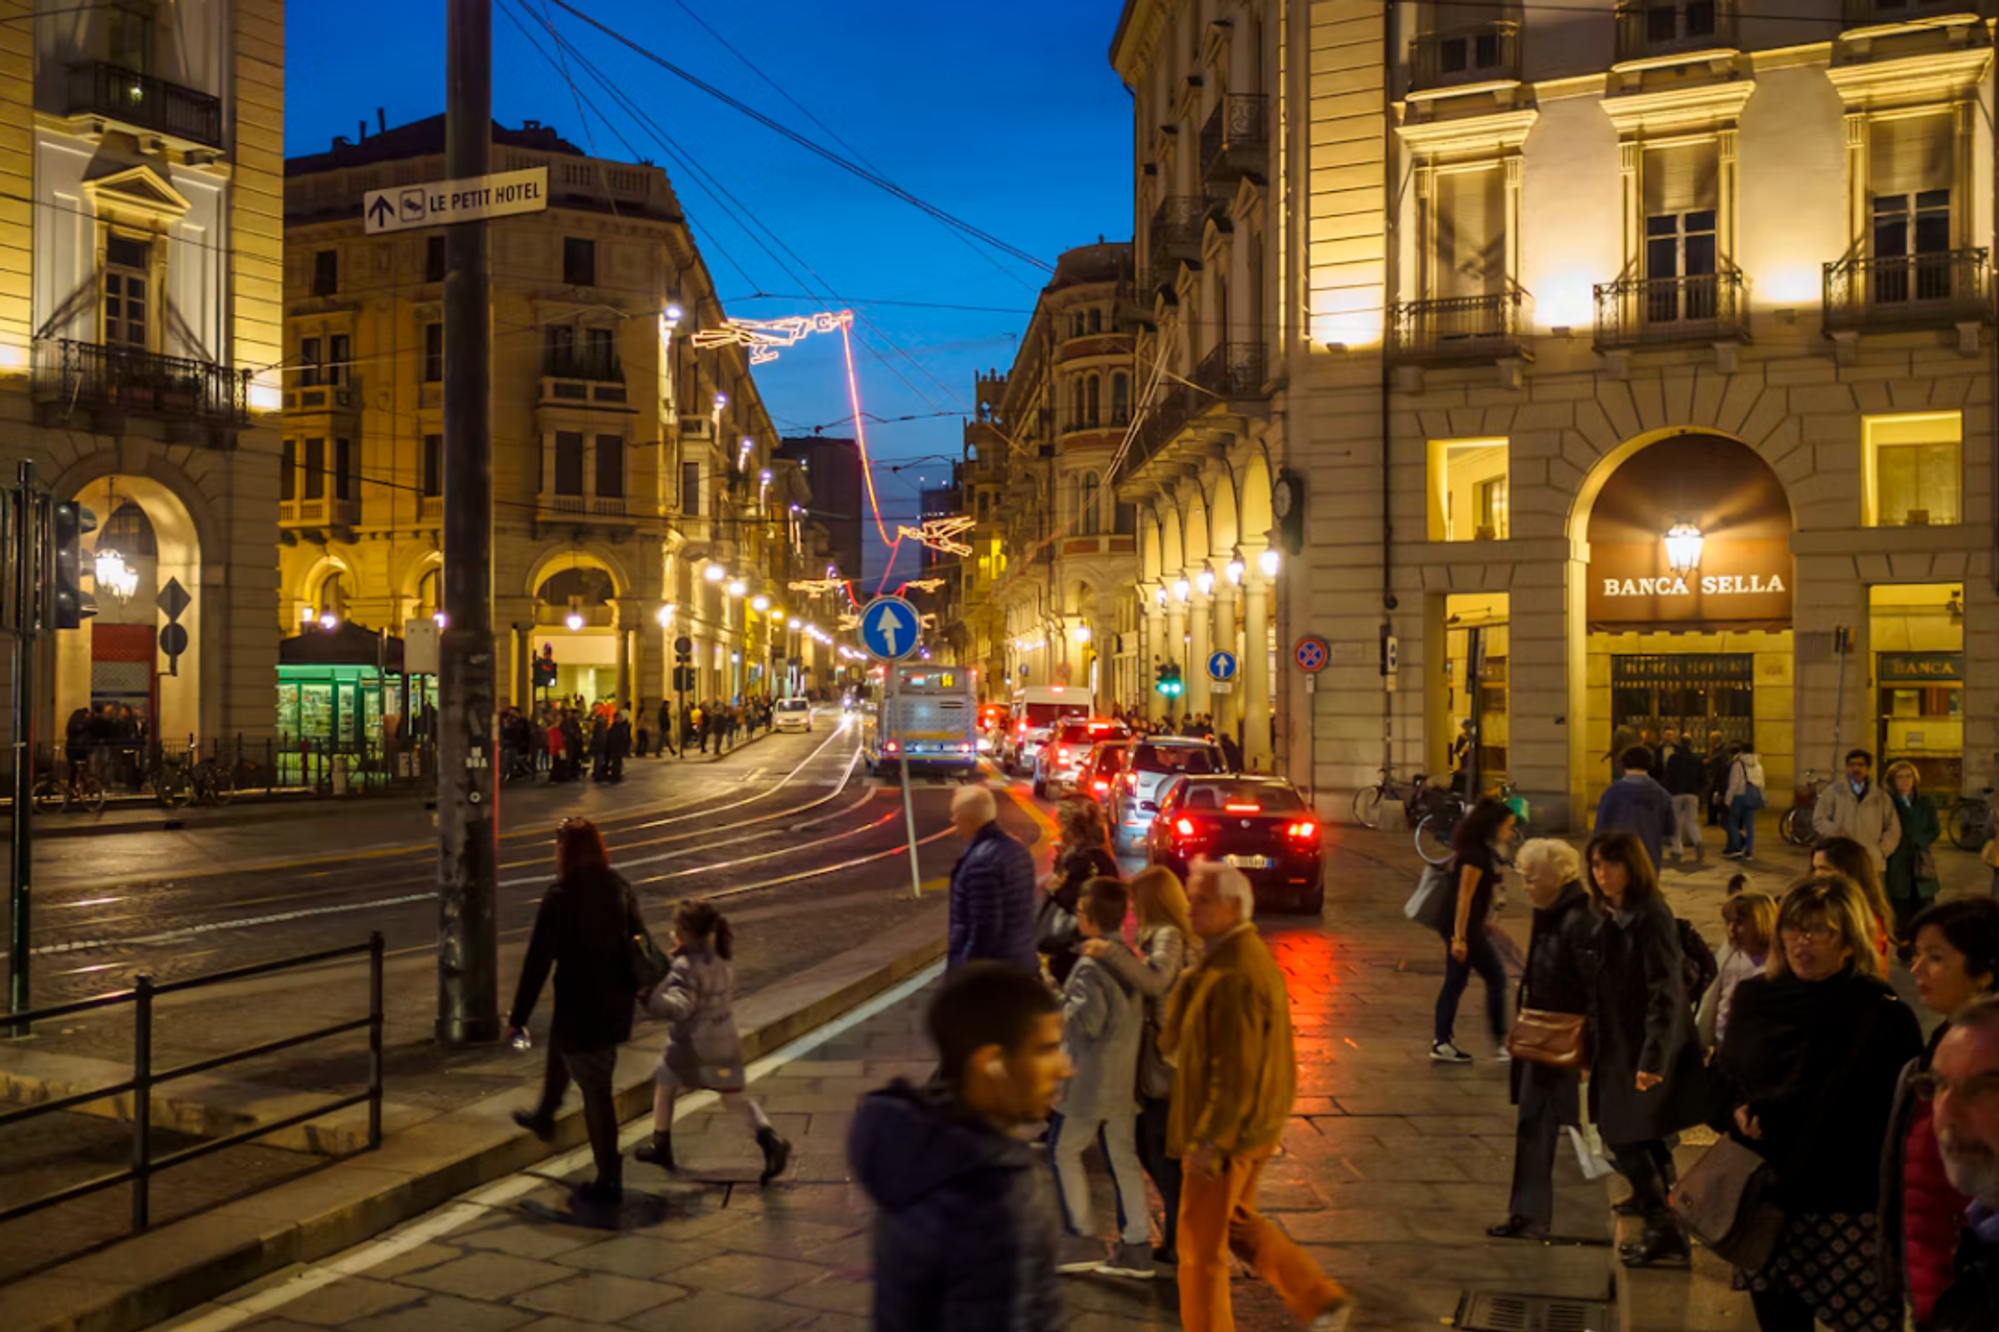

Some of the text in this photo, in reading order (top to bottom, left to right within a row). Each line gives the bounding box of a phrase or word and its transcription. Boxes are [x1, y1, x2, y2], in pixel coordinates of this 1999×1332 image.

[430, 182, 540, 212] LE PETIT HOTEL
[1604, 575, 1785, 596] BANCA SELLA
[1893, 662, 1954, 674] BANCA
